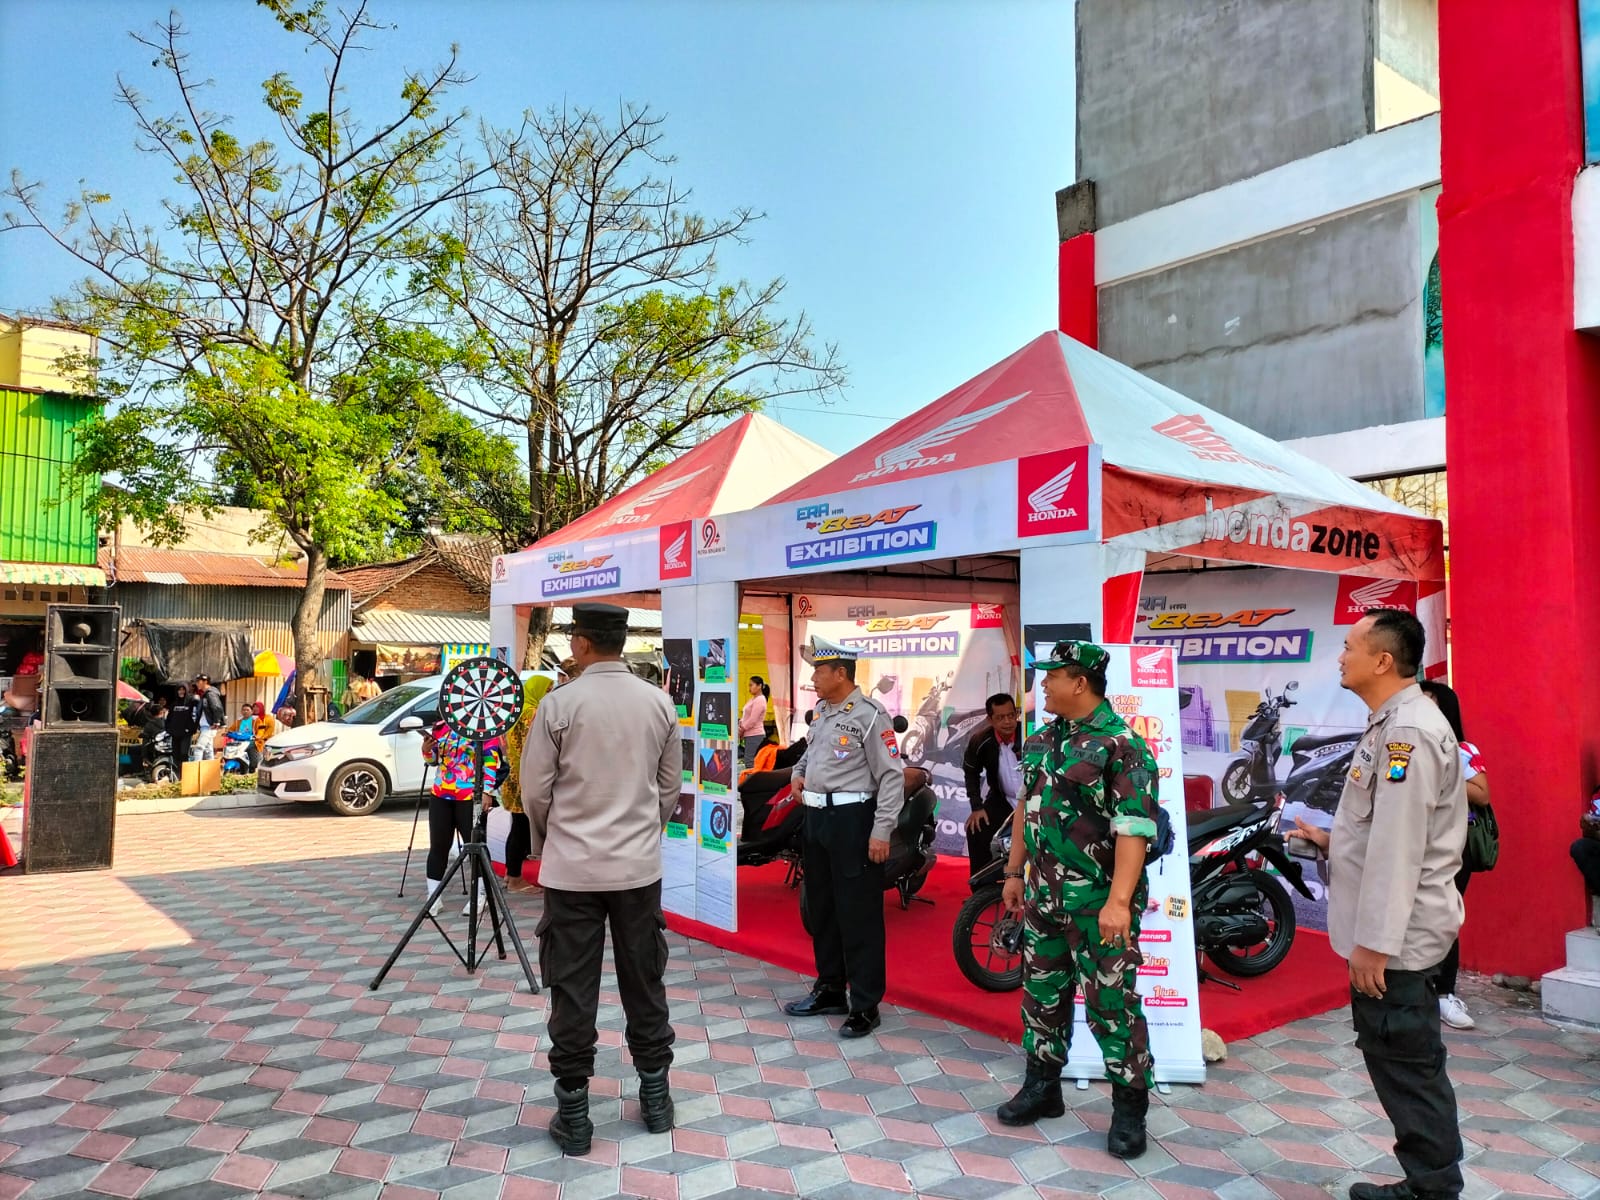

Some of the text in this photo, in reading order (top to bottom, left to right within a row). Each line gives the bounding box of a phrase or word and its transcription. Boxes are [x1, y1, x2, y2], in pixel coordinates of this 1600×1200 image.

[848, 453, 957, 484] HONDA
[797, 503, 829, 521] ERA
[1027, 507, 1078, 523] HONDA
[790, 527, 929, 562] EXHIBITION
[663, 561, 688, 571] HONDA
[543, 570, 617, 592] EXHIBITION
[848, 605, 875, 618] ERA
[835, 722, 860, 735] POLRI
